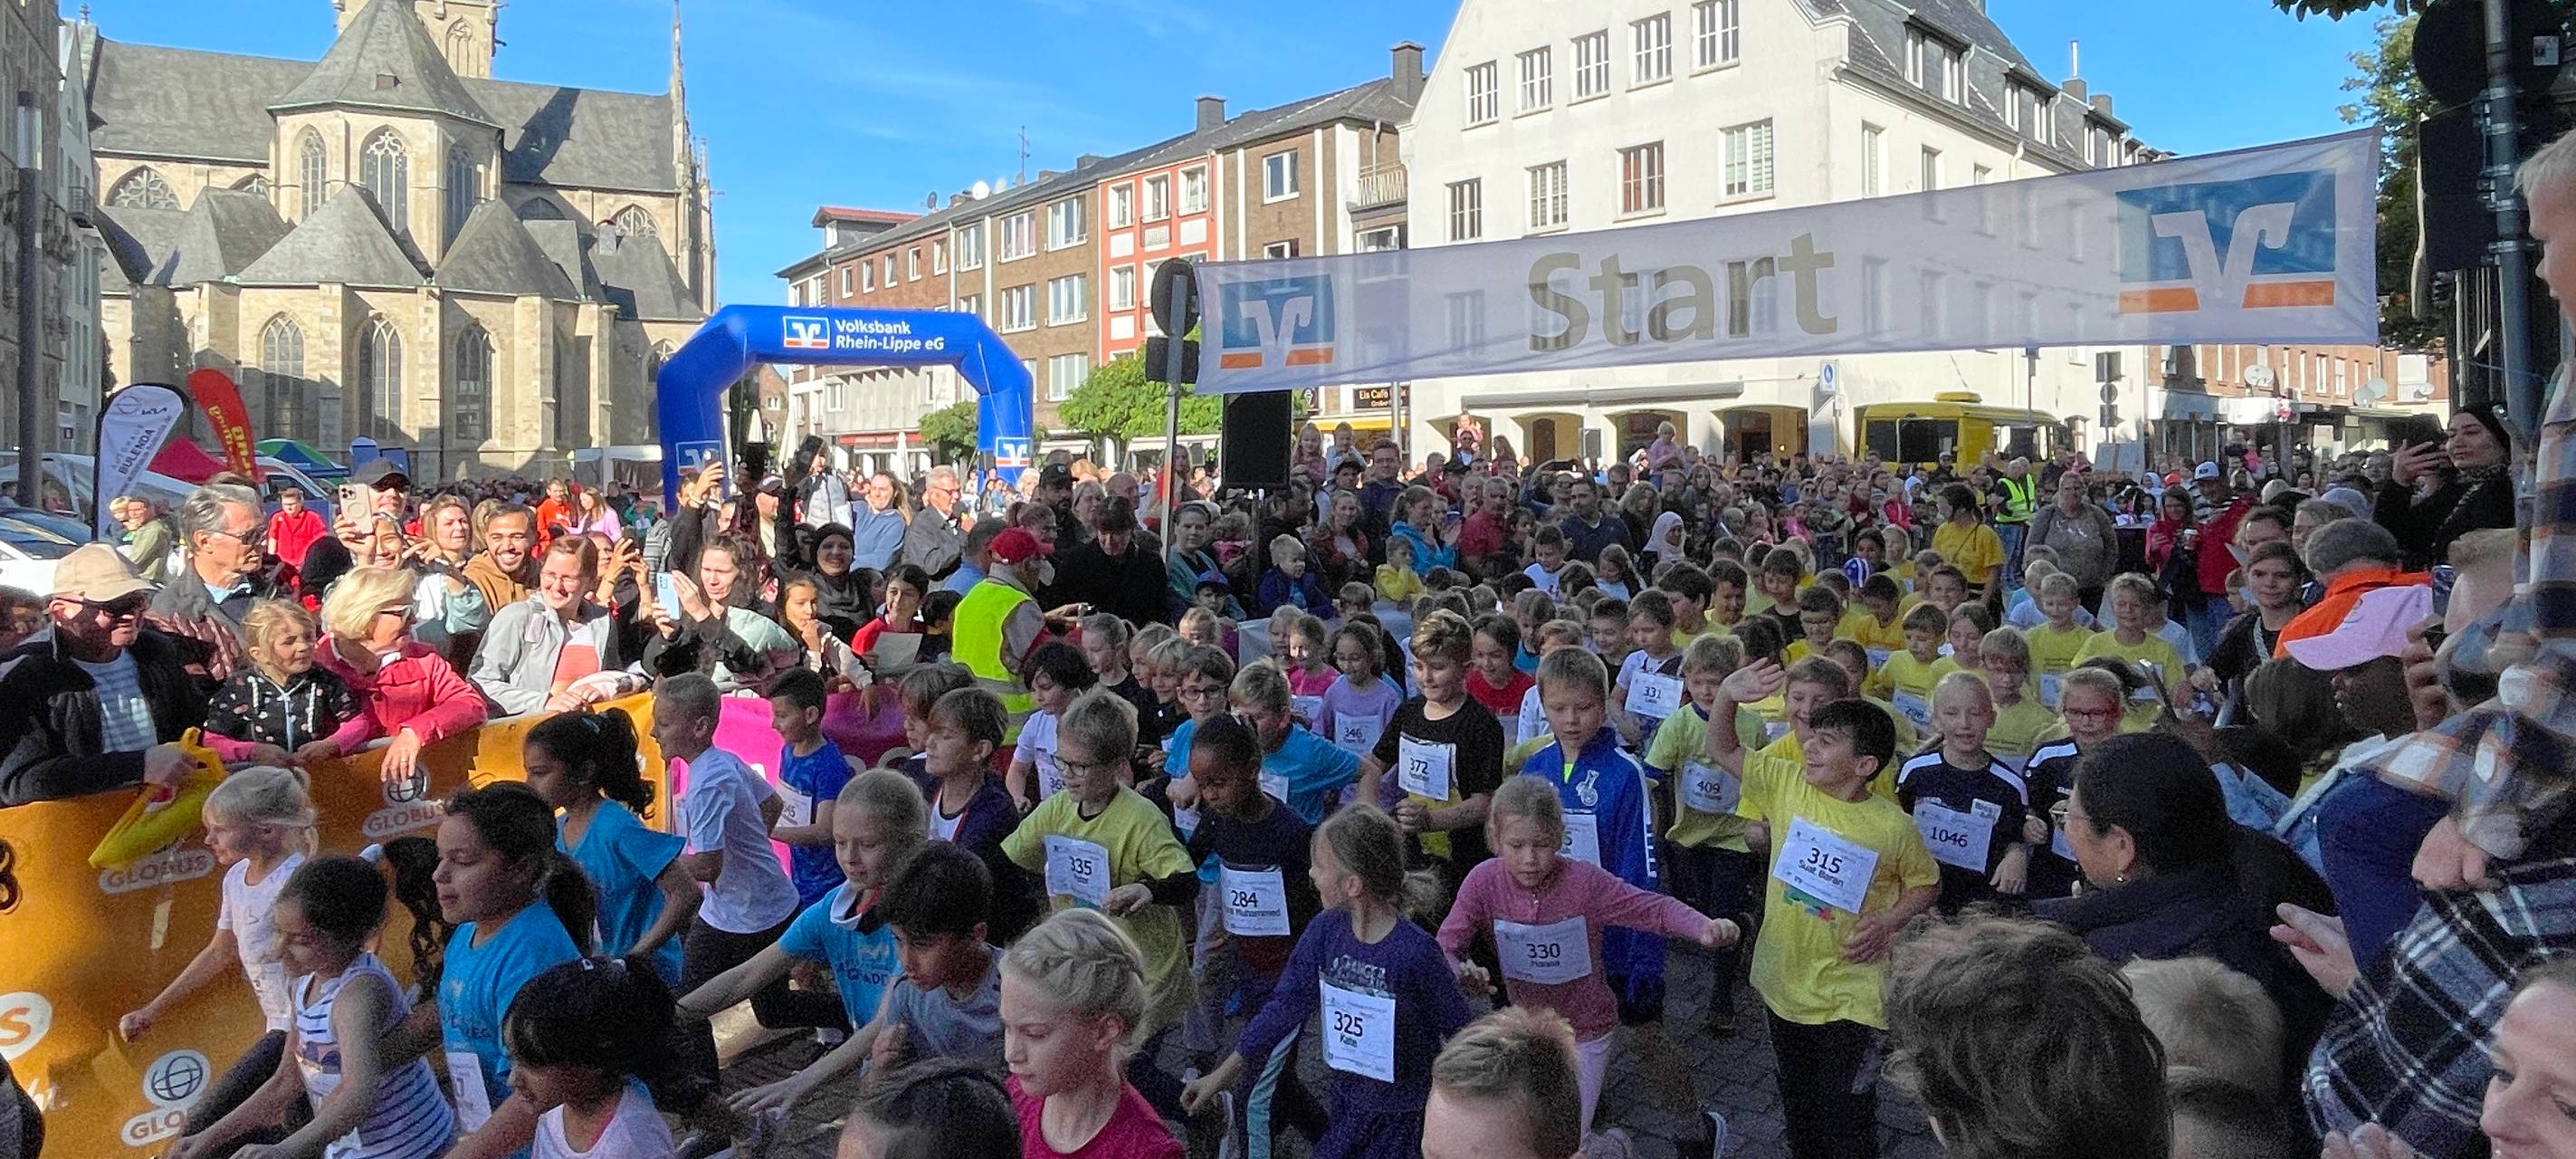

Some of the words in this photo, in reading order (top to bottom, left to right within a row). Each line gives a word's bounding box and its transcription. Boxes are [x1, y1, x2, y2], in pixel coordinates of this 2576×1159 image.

[1528, 232, 1837, 352] Start
[835, 319, 911, 334] Volksbank
[835, 336, 921, 353] Rhein-Lippe
[925, 337, 945, 350] eG
[1360, 389, 1370, 400] Eis
[118, 428, 156, 475] BULENDA
[1643, 685, 1662, 699] 331
[1409, 756, 1429, 775] 372
[1696, 781, 1721, 794] 409
[1930, 826, 1968, 848] 1046
[1069, 856, 1092, 876] 335
[1807, 847, 1843, 874] 315
[1231, 889, 1258, 908] 284
[1525, 943, 1561, 959] 330
[1333, 1011, 1363, 1038] 325
[129, 1109, 186, 1141] GLO
